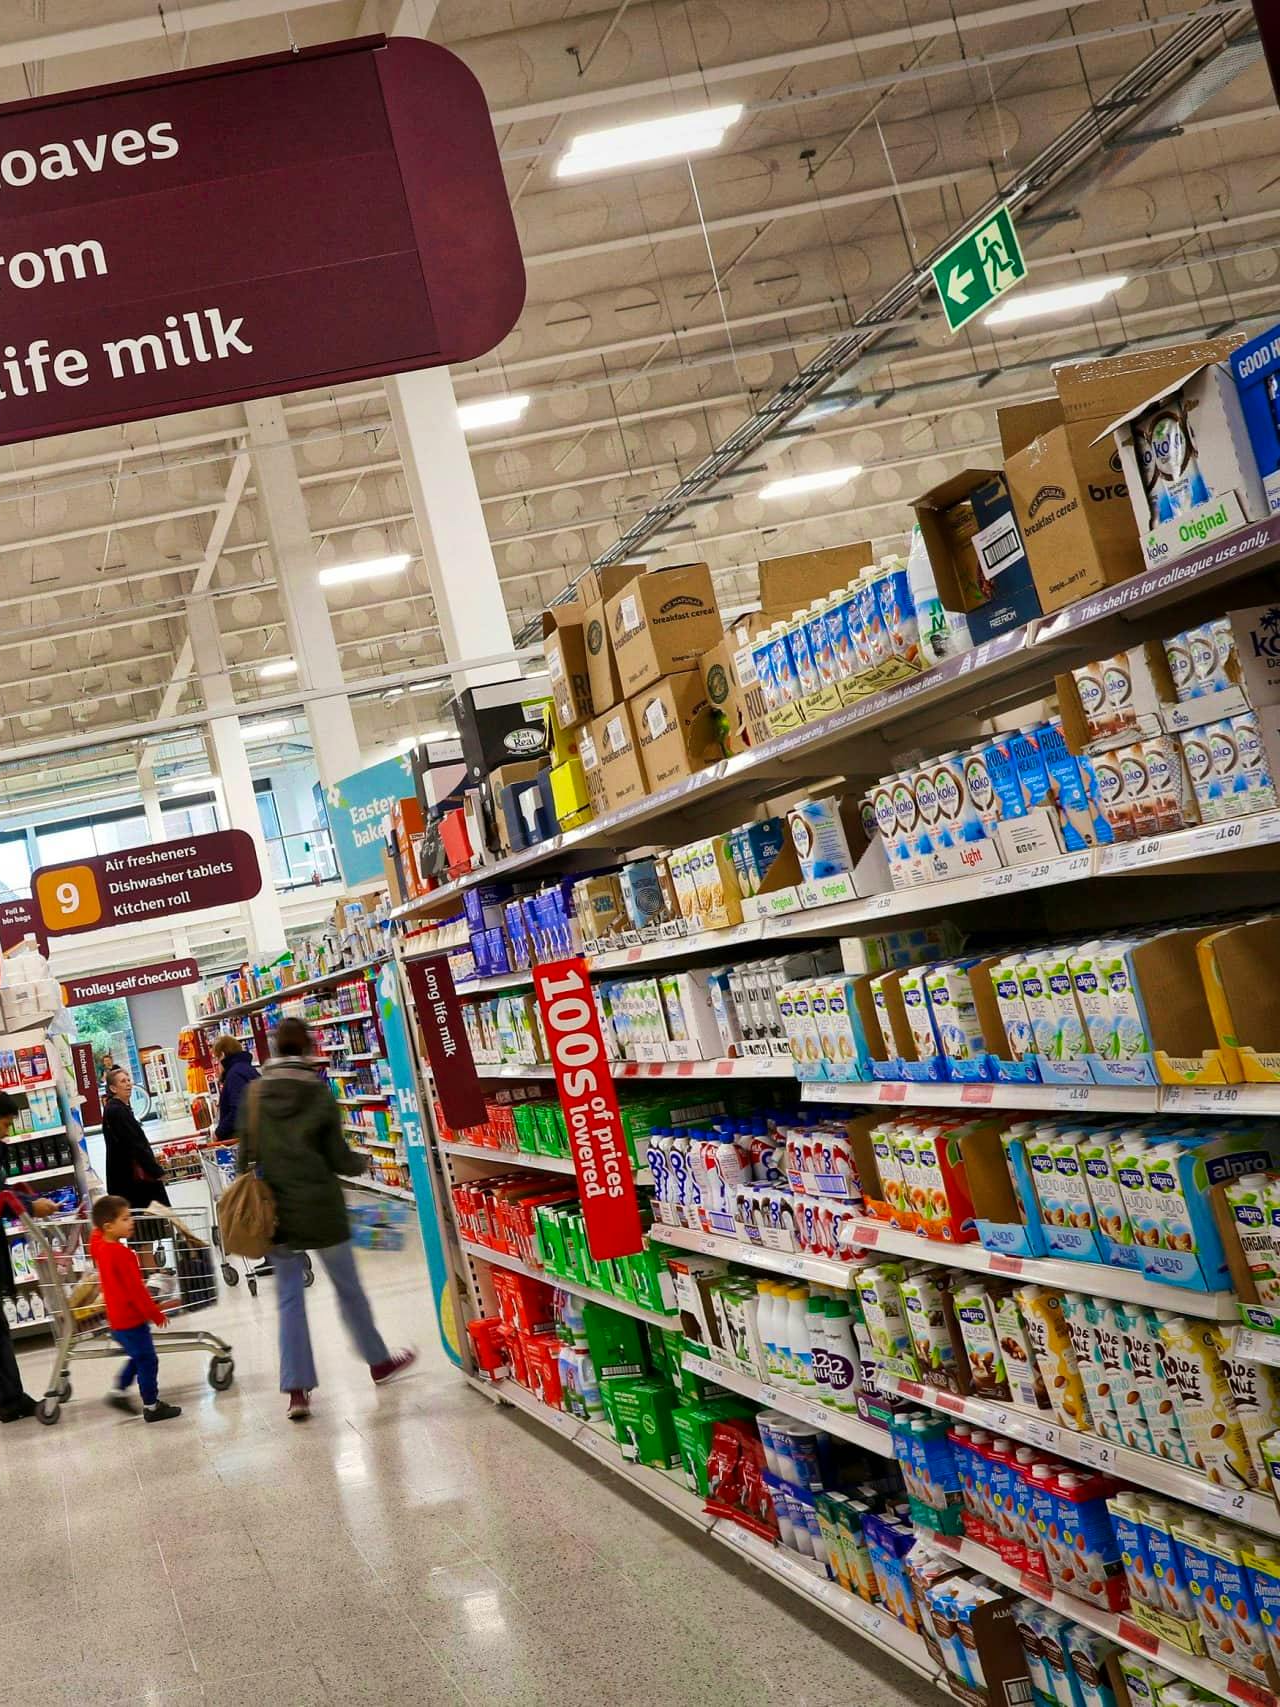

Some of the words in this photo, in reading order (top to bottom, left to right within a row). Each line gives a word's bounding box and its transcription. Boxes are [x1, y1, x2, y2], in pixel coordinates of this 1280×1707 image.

[103, 308, 252, 378] milk
[1238, 350, 1270, 379] GOOD
[1024, 512, 1056, 537] breakfast
[1056, 498, 1078, 519] cereal
[1179, 507, 1228, 542] Original
[1147, 542, 1168, 561] koko
[1080, 607, 1102, 621] This
[1102, 587, 1131, 612] shelf
[1130, 587, 1141, 601] is
[1140, 578, 1157, 597] for
[1157, 555, 1213, 588] colleague
[1215, 545, 1237, 562] use
[1239, 530, 1270, 553] only.
[653, 611, 690, 625] breakfast
[691, 607, 715, 618] cereal
[513, 736, 535, 748] Real
[937, 783, 957, 799] koko
[969, 776, 990, 792] koko
[895, 798, 913, 814] koko
[917, 791, 936, 806] koko
[349, 795, 396, 825] Easter
[351, 820, 386, 848] bake
[1216, 825, 1241, 840] £1.60
[1136, 841, 1160, 856] £1.60
[105, 858, 124, 873] Air
[127, 845, 197, 868] fresheners
[960, 850, 983, 867] Light
[108, 872, 184, 895] Dishwasher
[186, 861, 233, 879] tablets
[821, 880, 848, 898] Original
[56, 883, 80, 914] 9
[113, 897, 166, 917] Kitchen
[167, 891, 191, 907] roll
[2, 916, 14, 925] bin
[73, 982, 115, 999] Trolley
[115, 976, 138, 991] self
[138, 966, 192, 985] checkout
[424, 966, 441, 1001] Long
[999, 982, 1018, 996] alpro
[1024, 982, 1042, 995] alpro
[1051, 978, 1070, 992] alpro
[1077, 977, 1097, 991] alpro
[905, 990, 921, 1003] alpro
[932, 990, 949, 1003] alpro
[433, 1002, 447, 1026] life
[540, 969, 600, 1097] 100s
[438, 1025, 458, 1058] milk
[1169, 1060, 1203, 1071] VANILLA
[1213, 1090, 1238, 1101] £1.40
[591, 1096, 615, 1121] of
[570, 1103, 606, 1199] lowered
[592, 1126, 624, 1198] prices
[1032, 1157, 1051, 1171] alpro
[1056, 1159, 1076, 1173] alpro
[1087, 1162, 1107, 1177] alpro
[1212, 1153, 1267, 1180] alpro
[1120, 1172, 1142, 1187] alpro
[1151, 1174, 1172, 1189] alpro
[1237, 1207, 1261, 1224] alpro
[1154, 1256, 1183, 1272] ALMOND
[961, 1309, 985, 1322] alpro
[1045, 1431, 1054, 1442] £2
[1100, 1450, 1109, 1461] £2
[1233, 1495, 1244, 1509] £2
